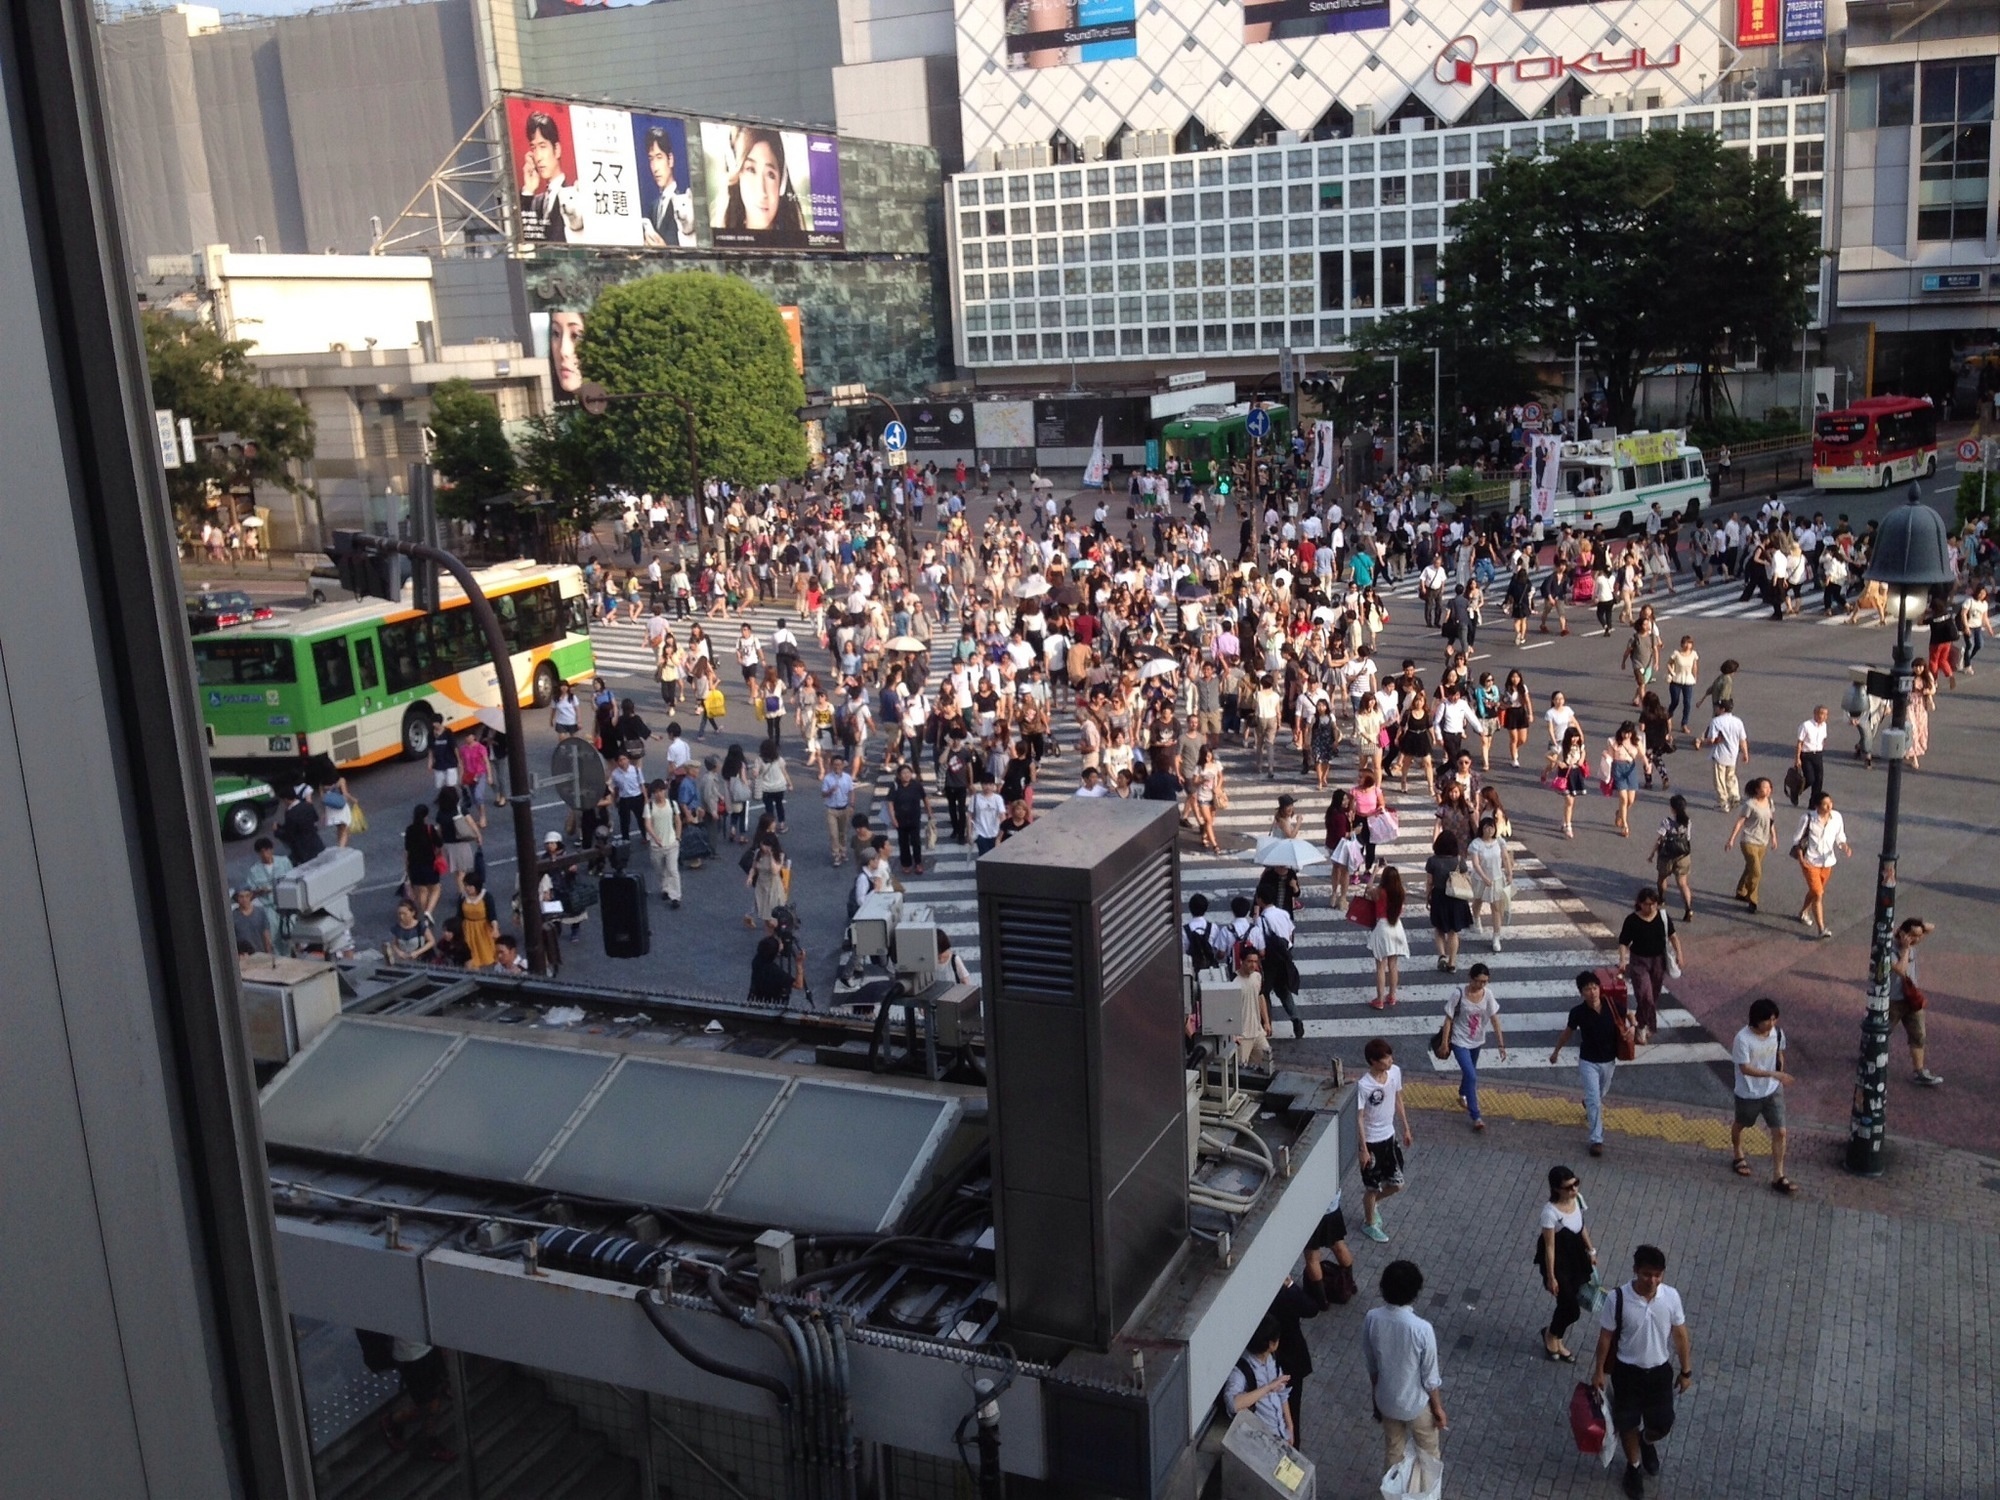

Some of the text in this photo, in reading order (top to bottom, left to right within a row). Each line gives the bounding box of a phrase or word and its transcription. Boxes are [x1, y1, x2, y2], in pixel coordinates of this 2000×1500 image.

[1063, 28, 1110, 42] SoundTrue
[1474, 43, 1681, 85] TOKYU
[592, 160, 623, 183] スマ
[594, 189, 629, 217] 放題
[159, 416, 175, 463] 渋谷駅前
